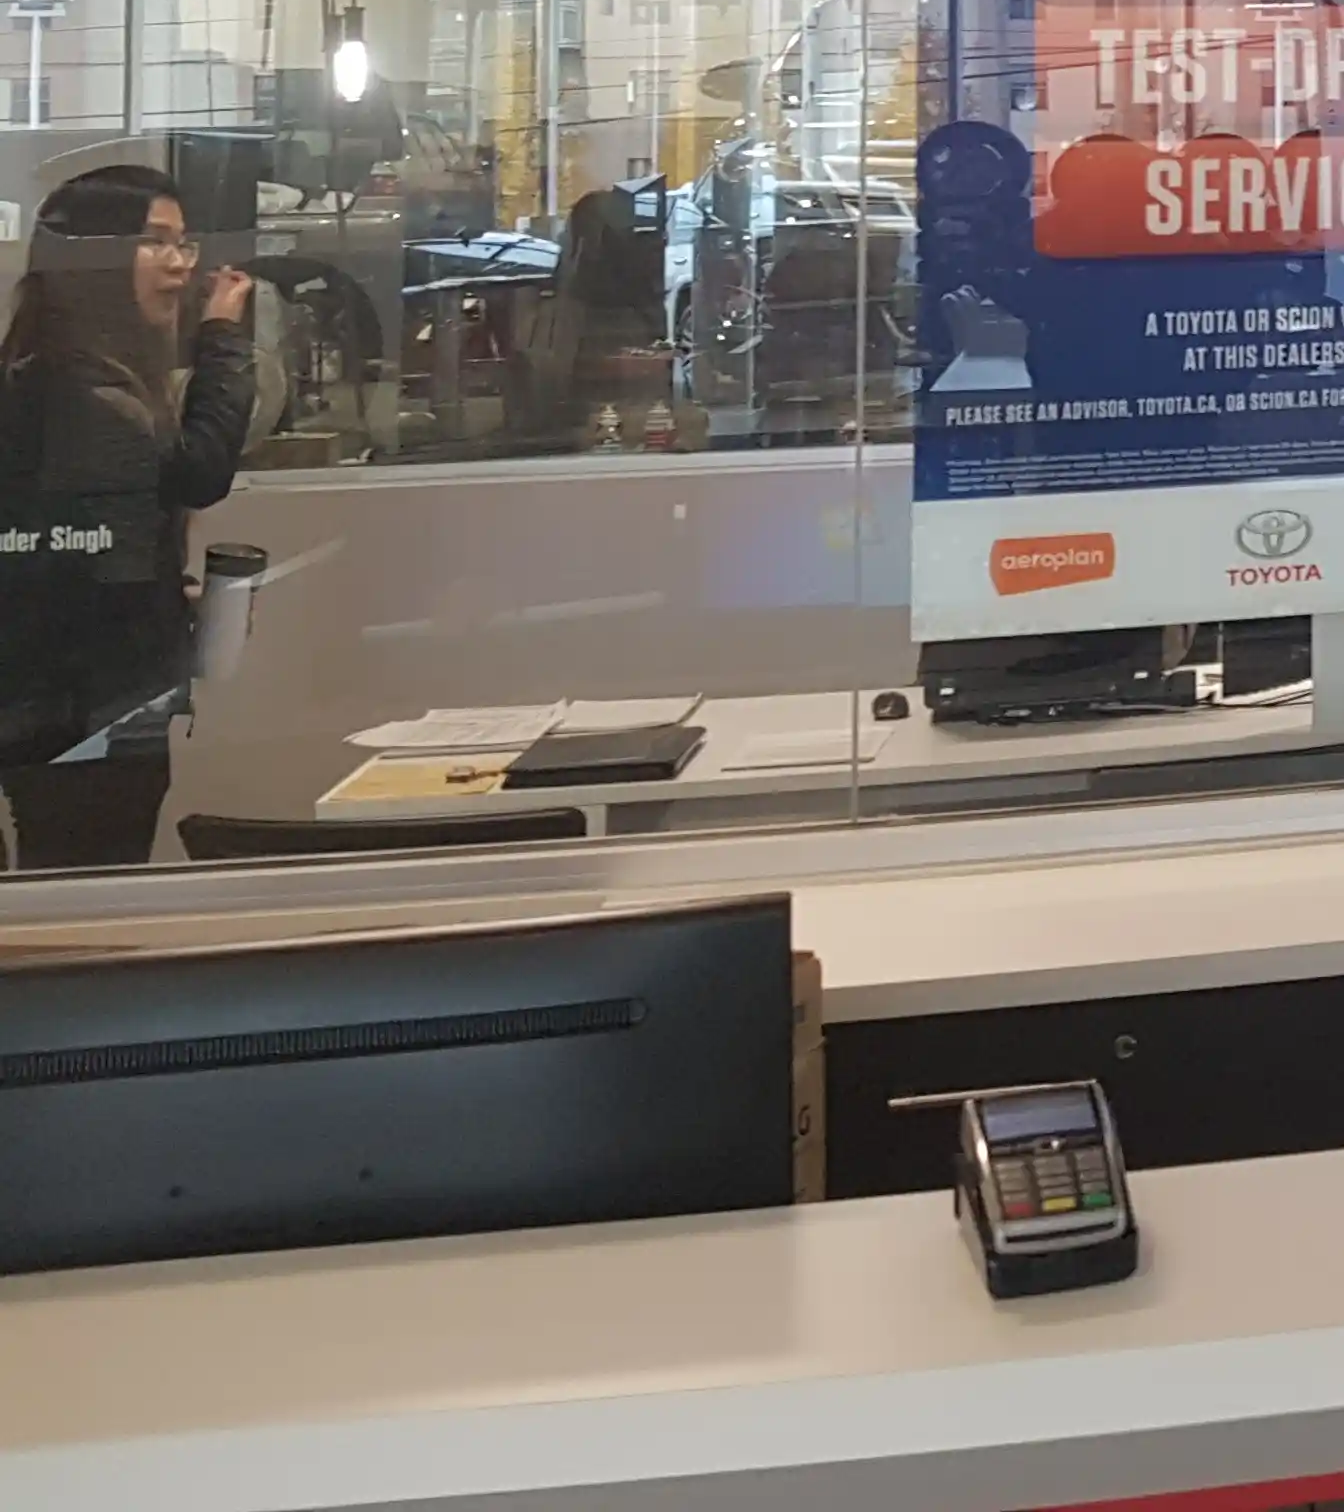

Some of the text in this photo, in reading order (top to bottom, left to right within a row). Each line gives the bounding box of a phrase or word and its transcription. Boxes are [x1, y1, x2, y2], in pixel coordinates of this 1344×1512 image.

[1145, 312, 1158, 336] A
[1164, 309, 1238, 336] TOYOTA
[1244, 307, 1270, 333] OR
[1275, 305, 1335, 332] SCION
[1183, 347, 1208, 371] AT
[1212, 344, 1258, 371] THIS
[946, 404, 1002, 426] PLEASE
[1006, 402, 1034, 423] SEE
[1037, 401, 1058, 421] AN
[50, 524, 113, 555] Singh
[1000, 547, 1105, 573] aeroplan
[1225, 563, 1322, 587] TOYOTA
